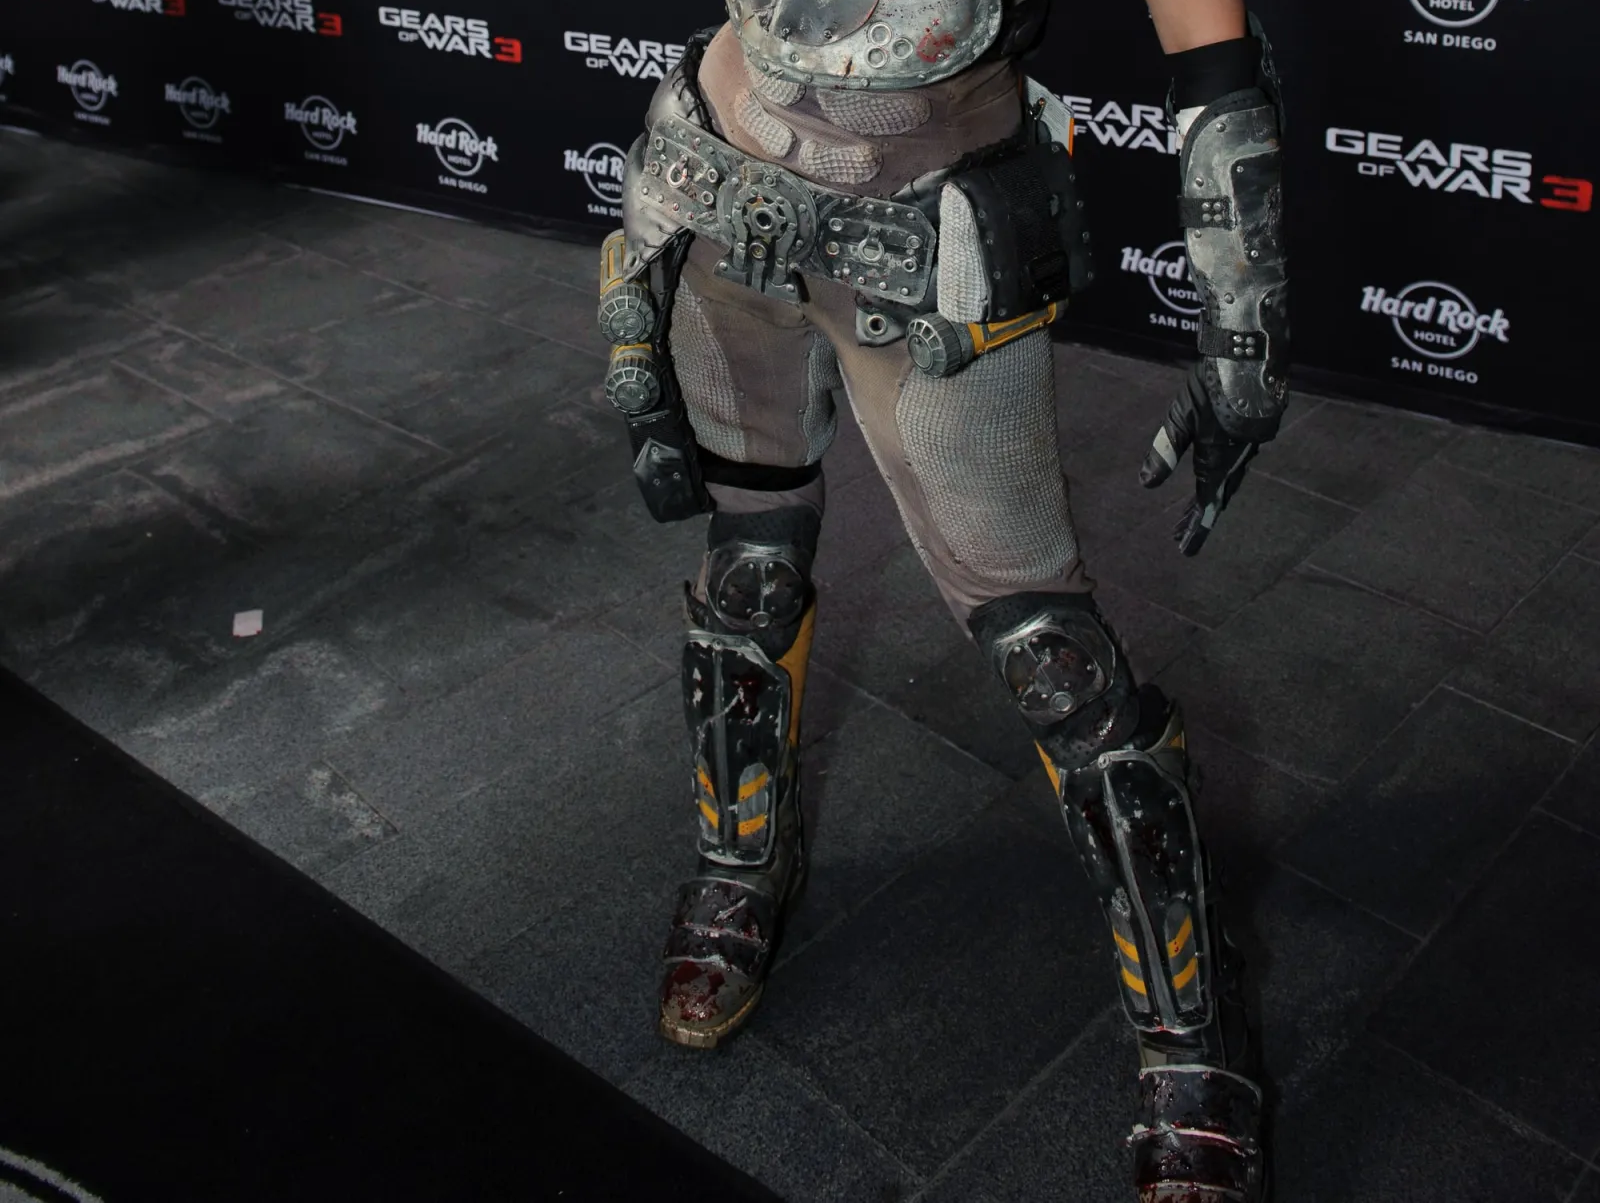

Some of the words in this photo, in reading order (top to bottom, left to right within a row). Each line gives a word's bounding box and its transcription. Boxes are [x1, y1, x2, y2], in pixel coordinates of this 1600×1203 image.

[377, 5, 489, 41] GEARS
[1403, 29, 1438, 45] SAN
[1441, 33, 1497, 51] DIEGO
[397, 30, 419, 43] OF
[415, 28, 493, 59] WAR
[493, 36, 523, 64] 3
[563, 30, 687, 66] GEARS
[585, 56, 610, 69] OF
[282, 101, 321, 126] Hard
[319, 106, 358, 135] Rock
[415, 122, 457, 150] Hard
[456, 130, 499, 162] Rock
[1324, 126, 1533, 179] GEARS
[562, 148, 609, 176] Hard
[437, 174, 457, 187] SAN
[457, 178, 487, 193] DIEGO
[1356, 160, 1396, 177] OF
[1391, 159, 1534, 204] WAR
[1539, 174, 1594, 213] 3
[1120, 246, 1186, 281] Hard
[1148, 312, 1177, 328] SAN
[1359, 284, 1437, 323] Hard
[1436, 298, 1510, 343] Rock
[1412, 328, 1457, 347] HOTEL
[1390, 355, 1423, 373] SAN
[1426, 362, 1478, 384] DIEGO
